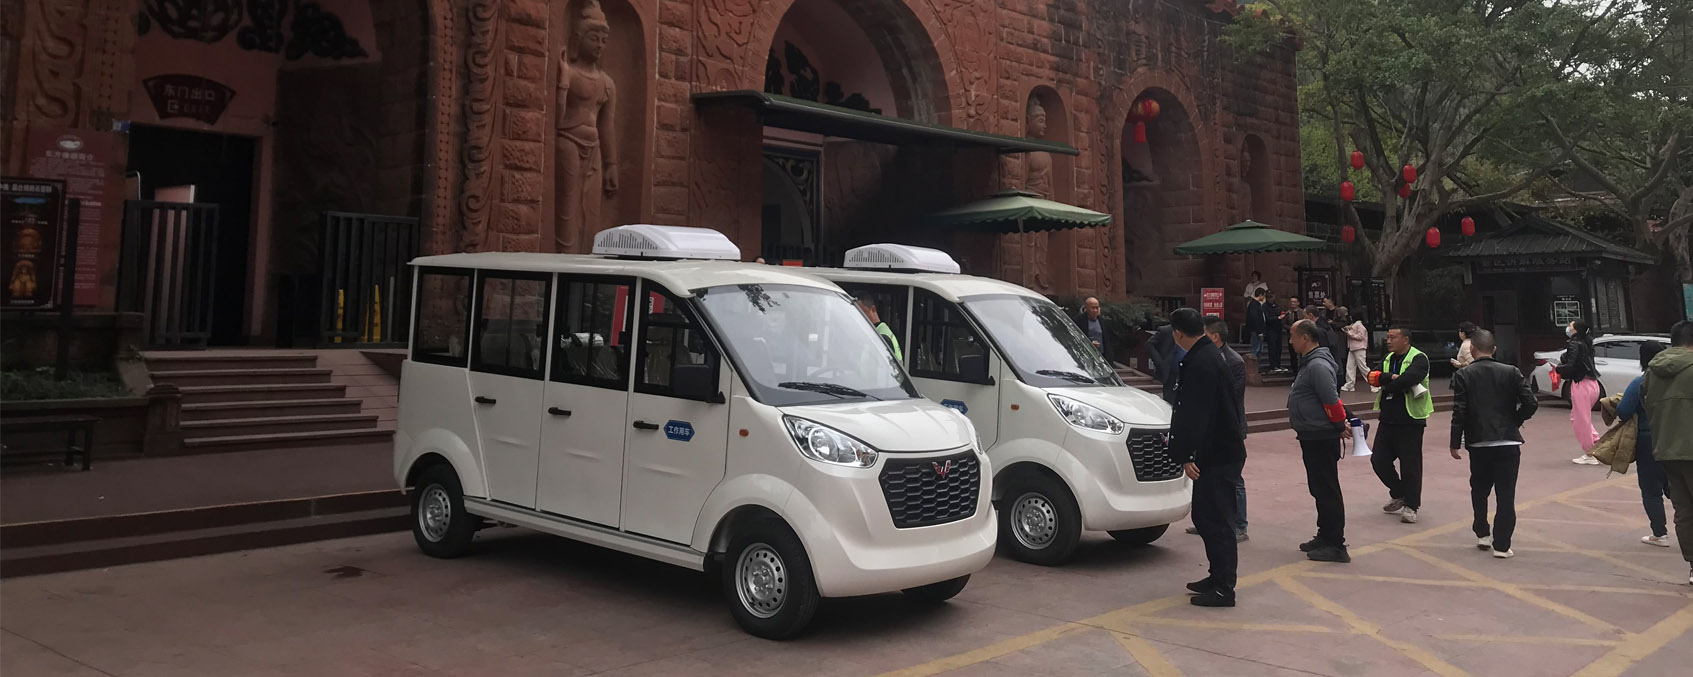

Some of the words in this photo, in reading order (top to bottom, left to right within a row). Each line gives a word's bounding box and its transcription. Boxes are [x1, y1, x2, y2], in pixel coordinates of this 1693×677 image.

[163, 84, 216, 101] 东门出口
[667, 425, 690, 437] 工作用车
